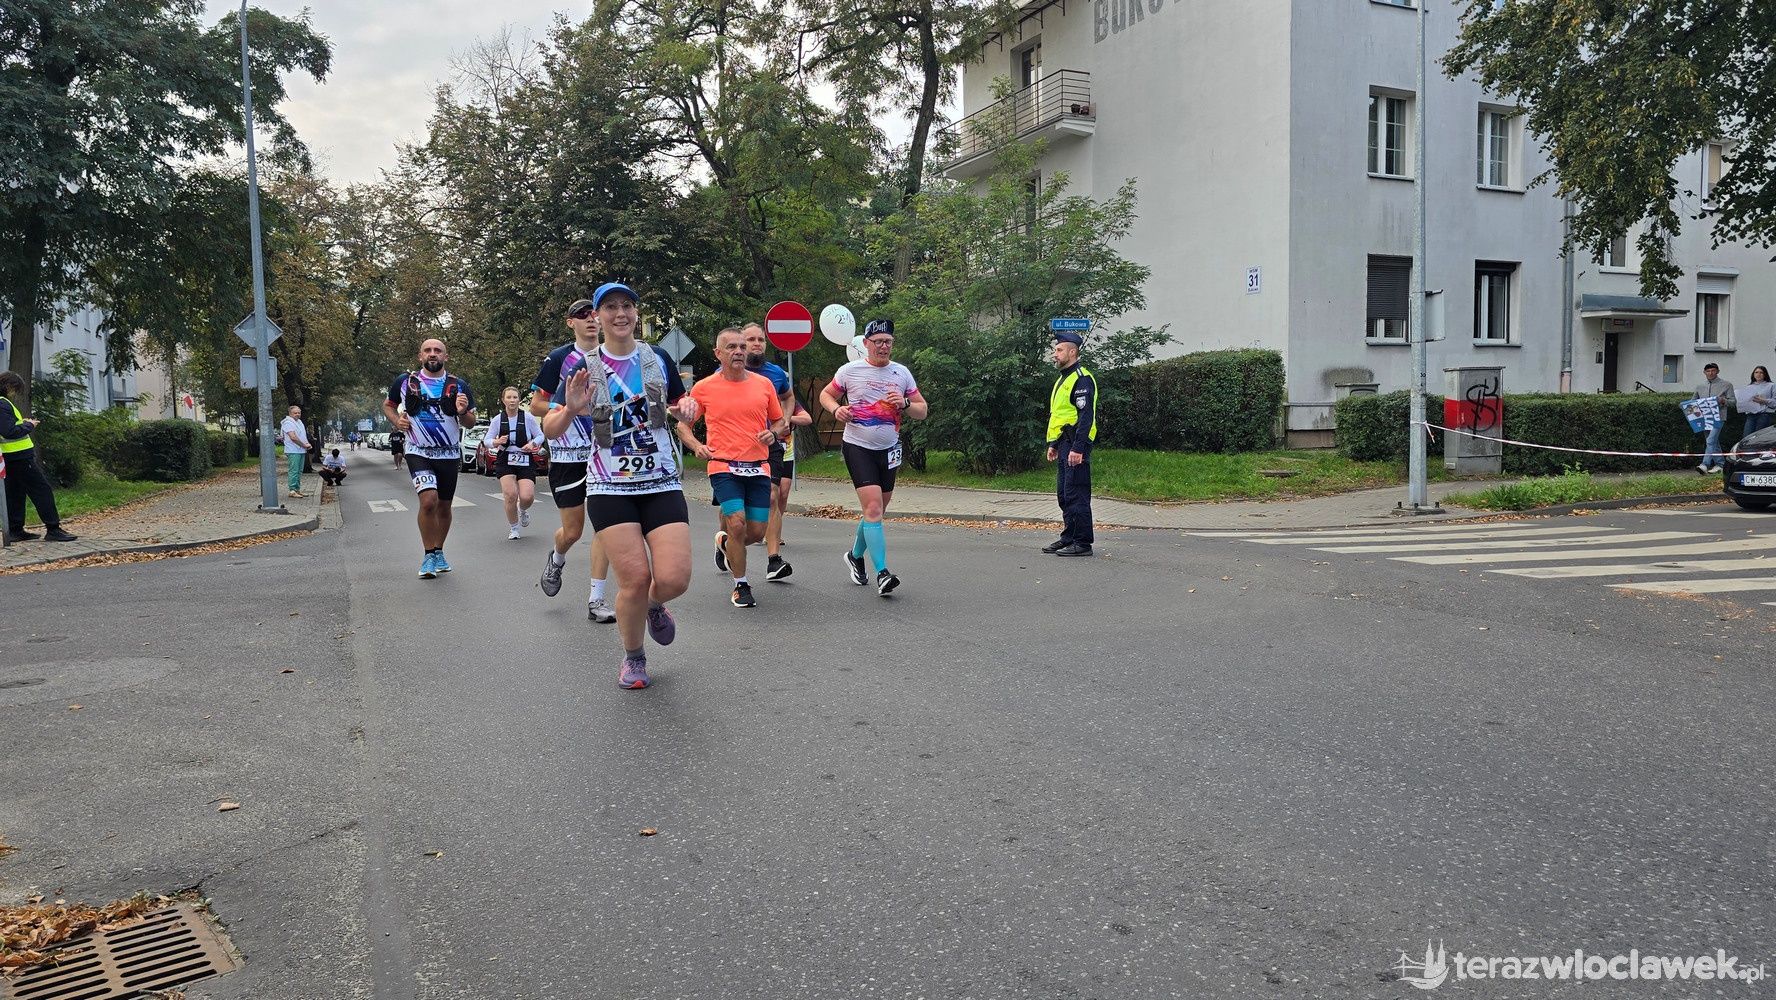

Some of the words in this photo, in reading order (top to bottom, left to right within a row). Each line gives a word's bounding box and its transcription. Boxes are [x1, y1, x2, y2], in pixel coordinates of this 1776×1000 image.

[1248, 274, 1258, 287] 31
[618, 455, 656, 472] 298
[415, 475, 434, 485] 400
